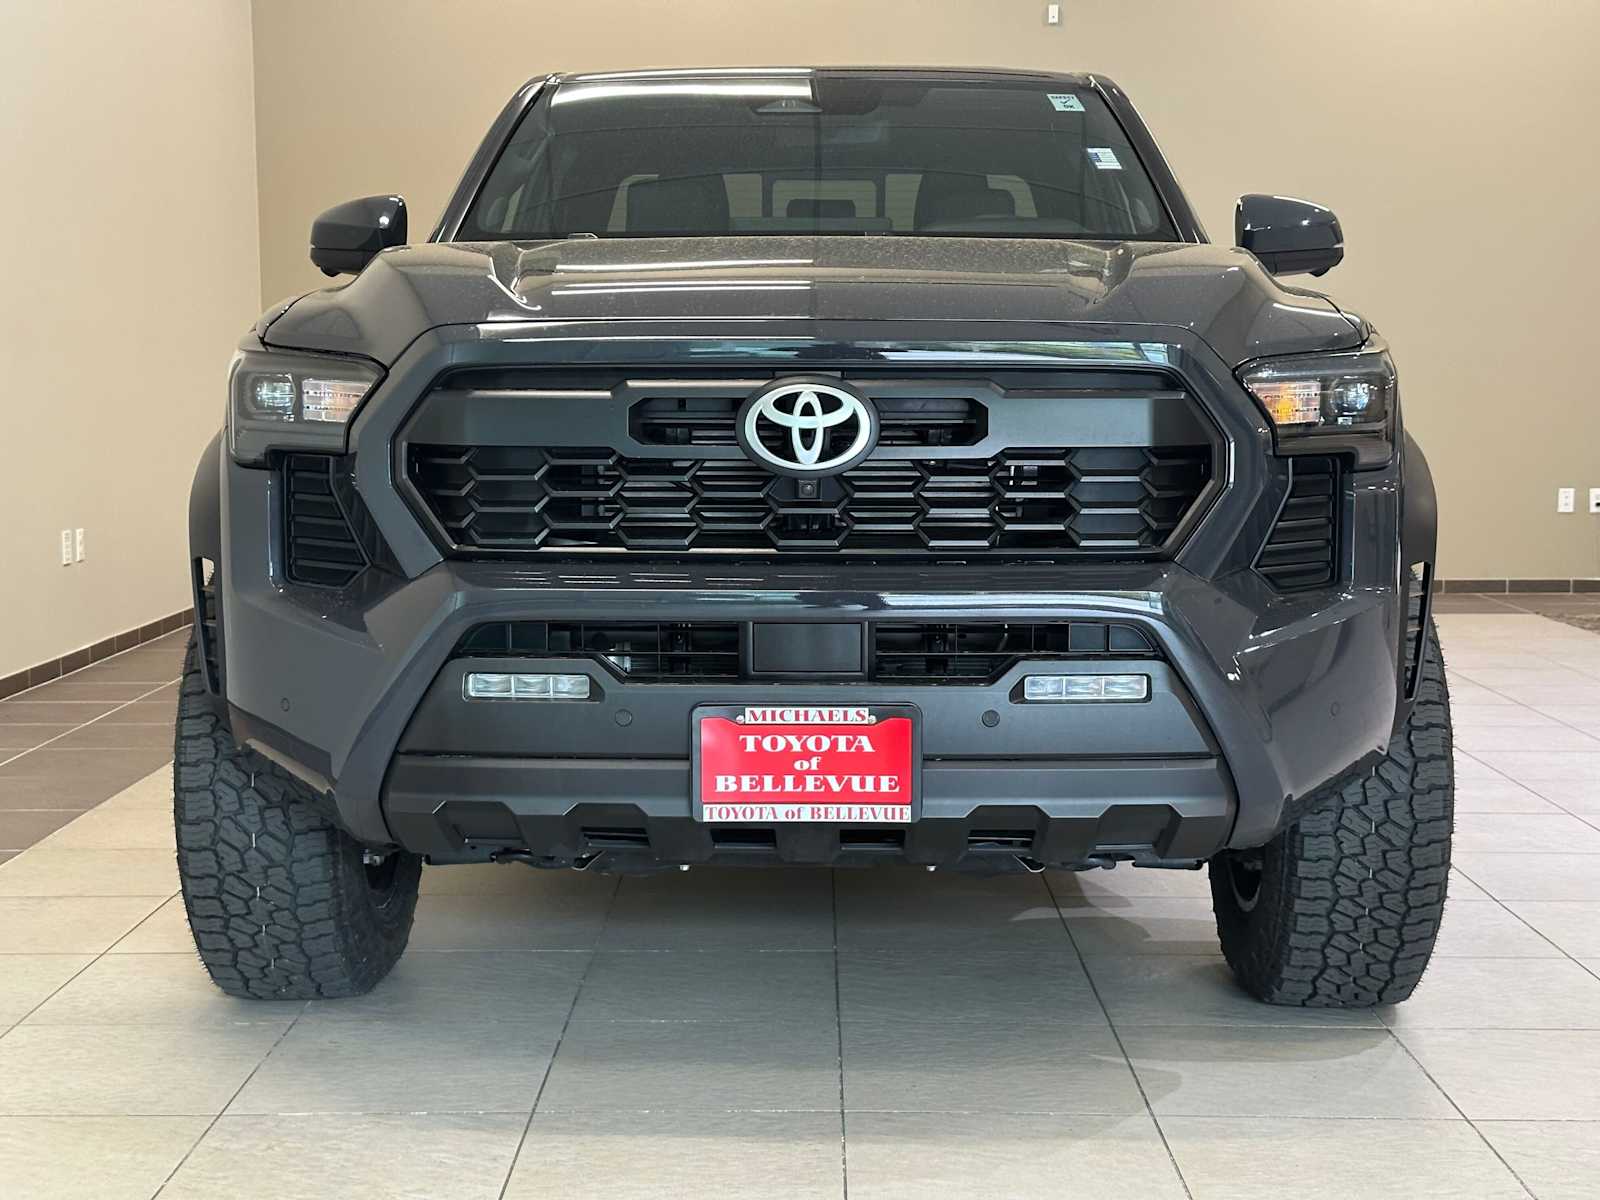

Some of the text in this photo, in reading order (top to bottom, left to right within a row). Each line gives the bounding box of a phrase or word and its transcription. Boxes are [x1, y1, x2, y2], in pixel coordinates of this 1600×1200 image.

[749, 709, 867, 722] MICHAELS
[739, 735, 875, 752] TOYOTA
[793, 756, 821, 771] of
[715, 775, 900, 792] BELLEVUE
[705, 806, 910, 820] TOYOTA of BELLEVUE
